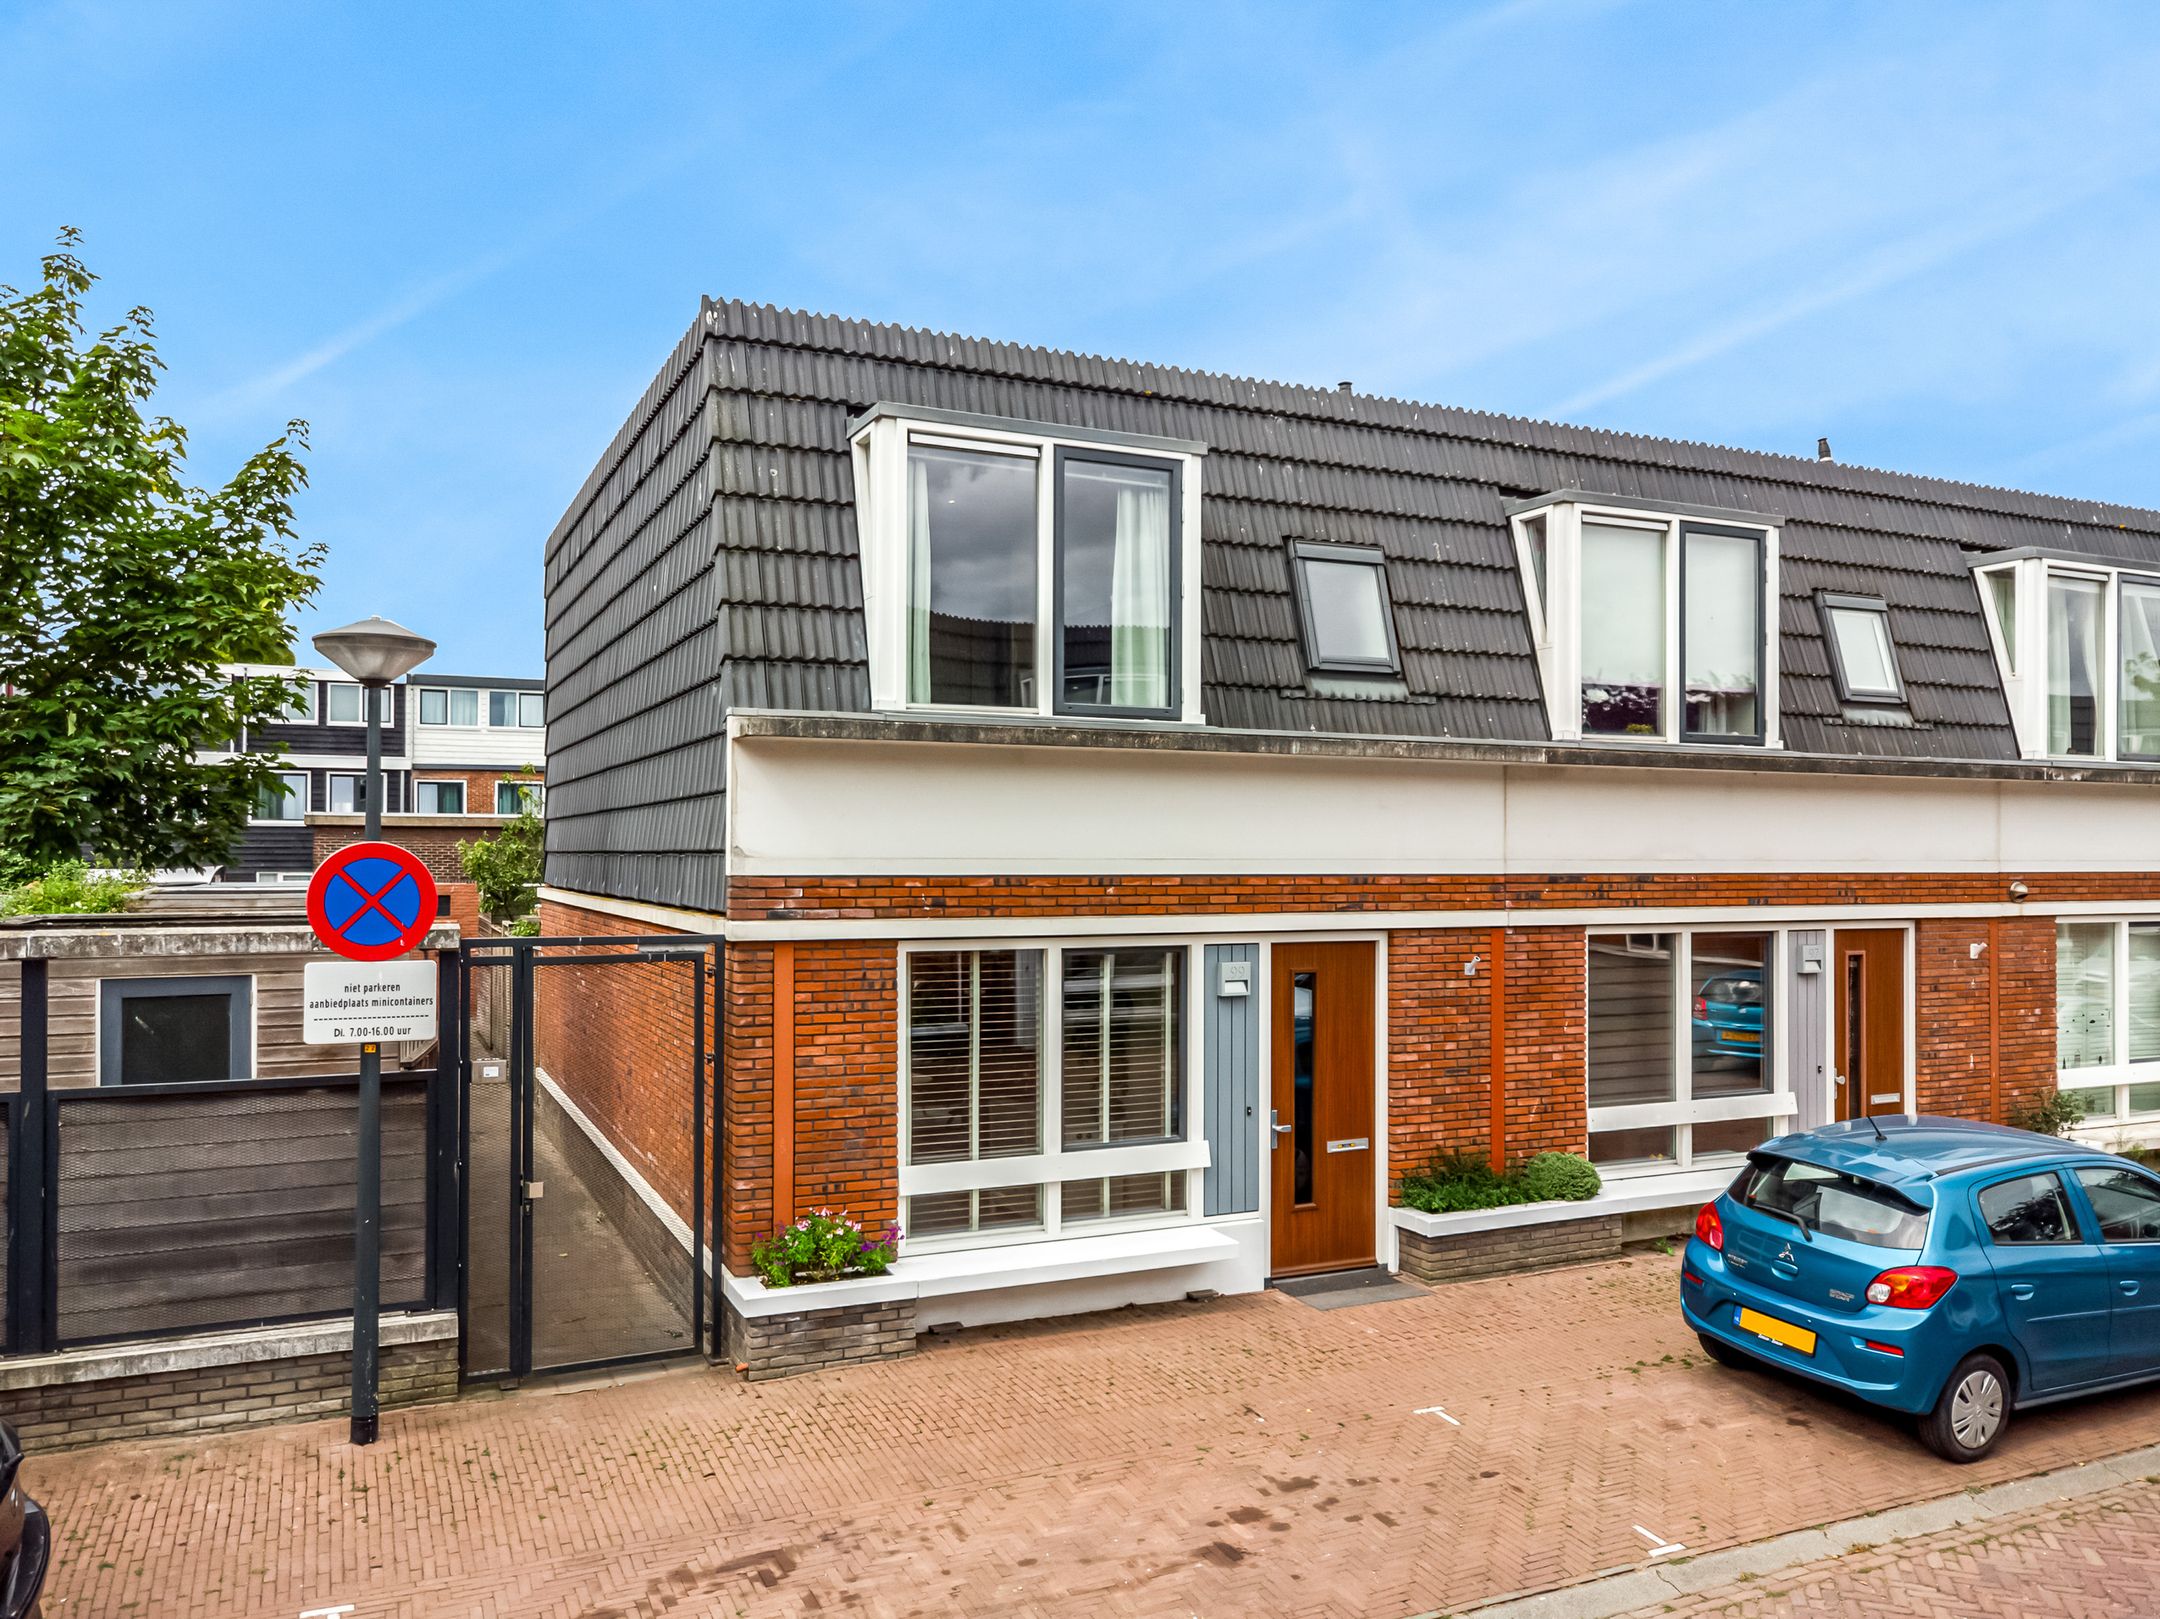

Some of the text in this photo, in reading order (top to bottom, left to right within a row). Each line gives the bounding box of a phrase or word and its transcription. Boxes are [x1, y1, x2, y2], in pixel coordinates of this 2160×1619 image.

[344, 983, 401, 995] niet parkeren
[309, 996, 433, 1010] aanbiedplaats minicontainers
[350, 1026, 395, 1037] 7.00-16.00
[397, 1026, 411, 1036] uur
